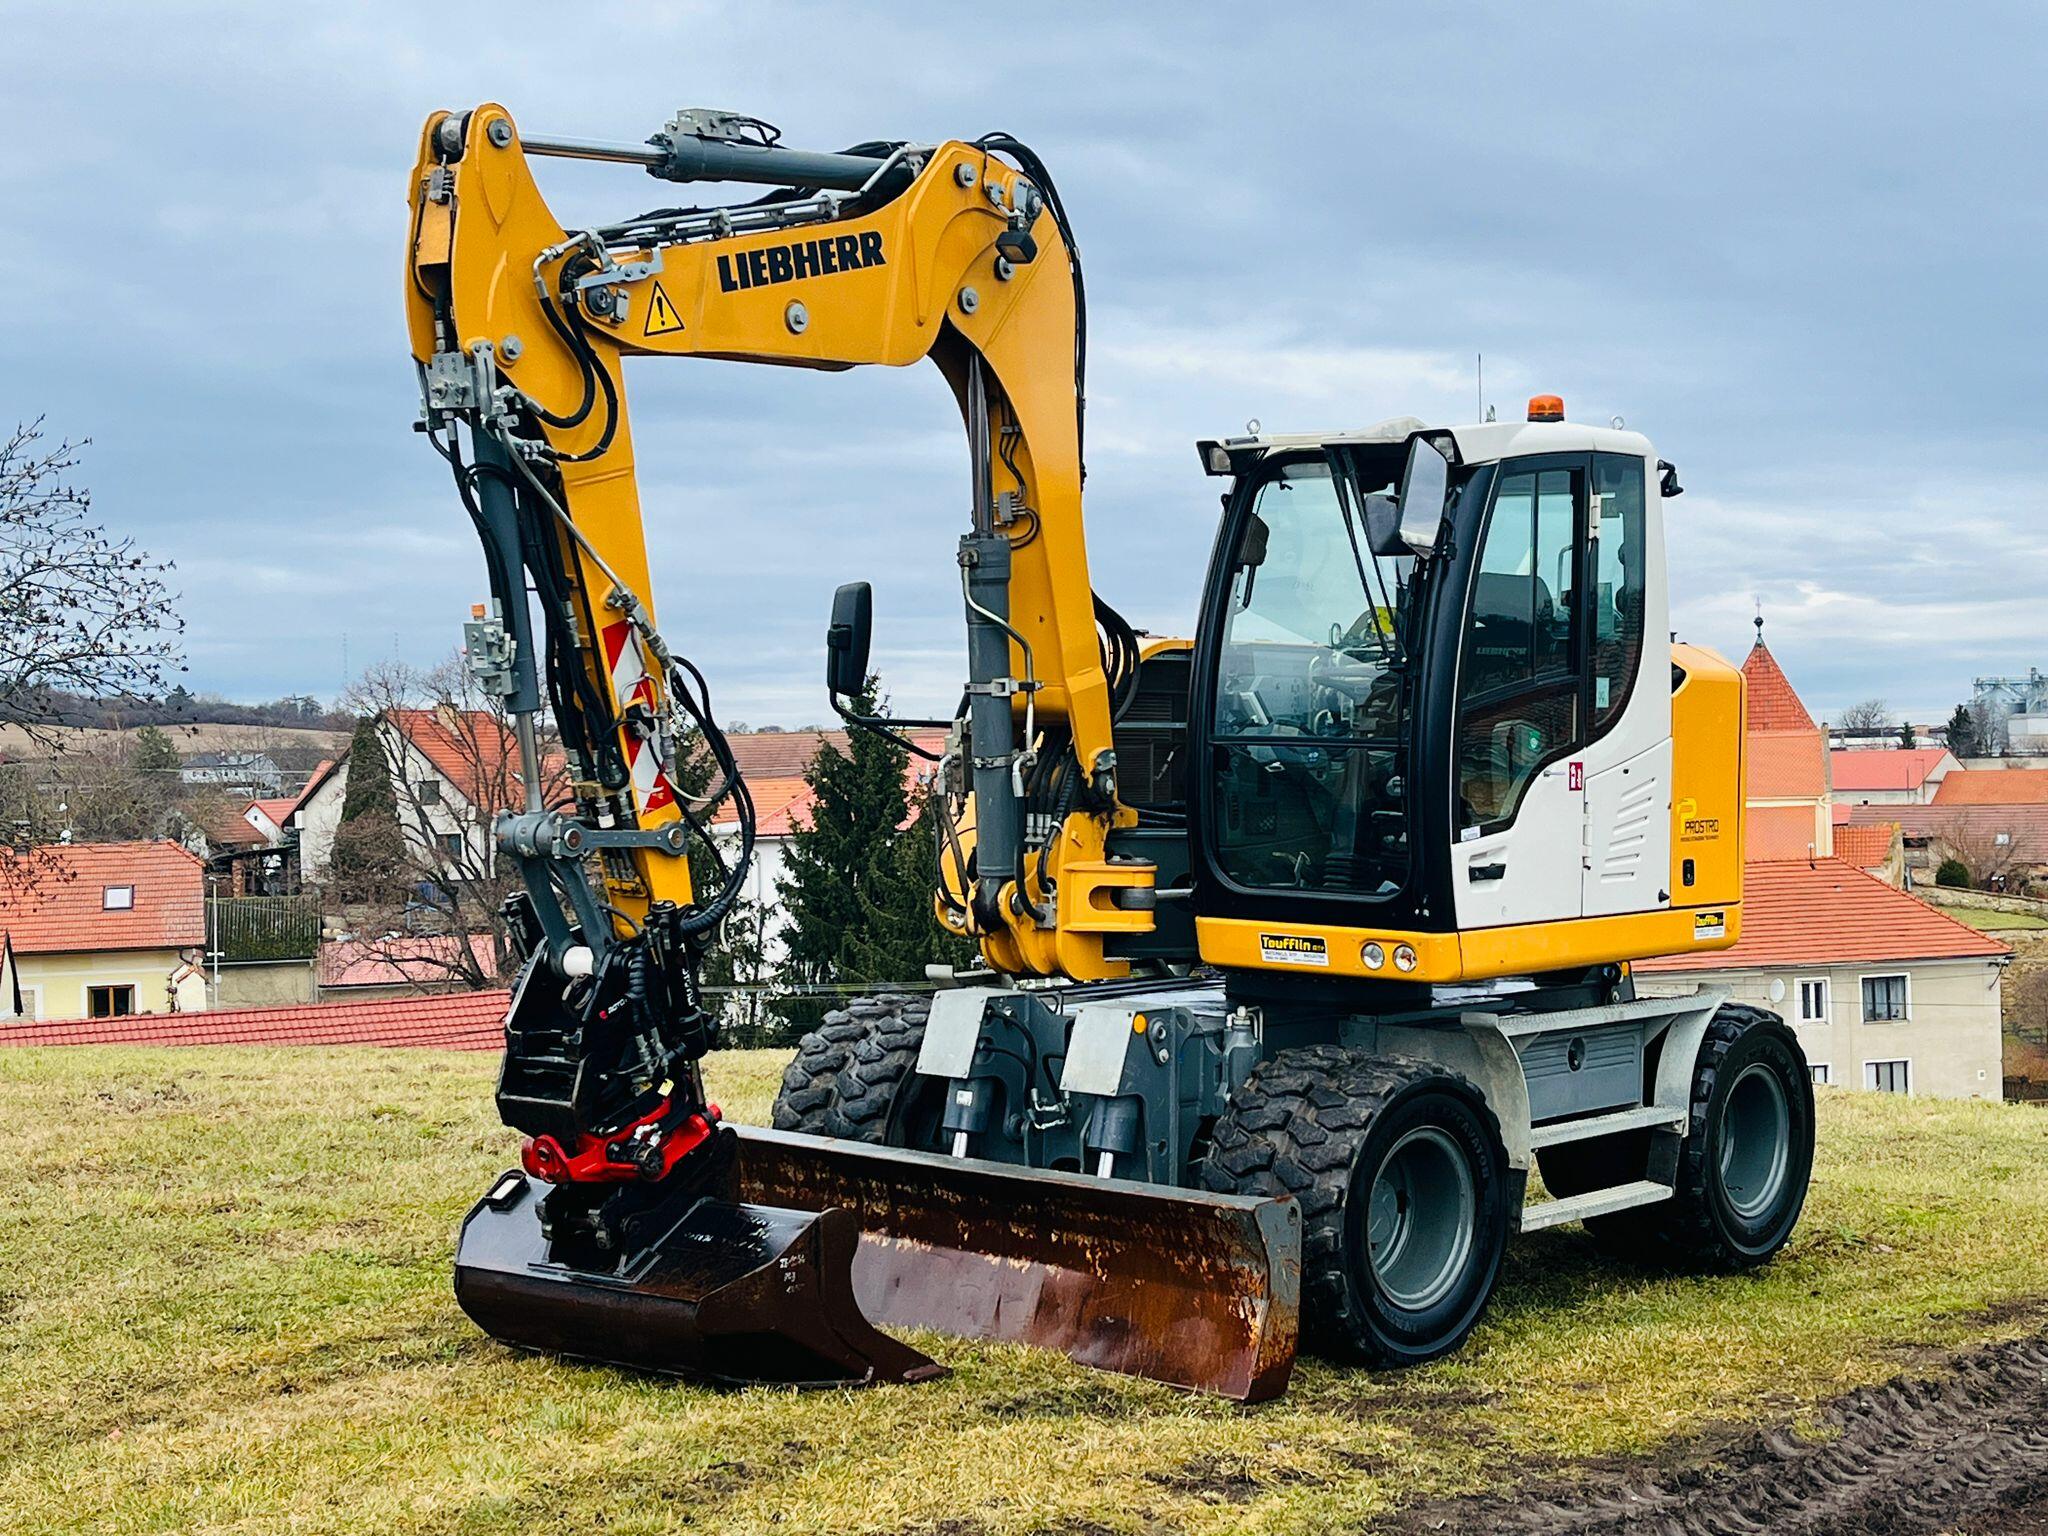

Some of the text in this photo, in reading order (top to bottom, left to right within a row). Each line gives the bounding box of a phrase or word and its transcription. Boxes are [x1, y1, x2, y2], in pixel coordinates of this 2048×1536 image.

[716, 230, 887, 293] LIEBHERR
[1685, 819, 1719, 834] PROSTRO
[1262, 936, 1311, 951] Toufflin
